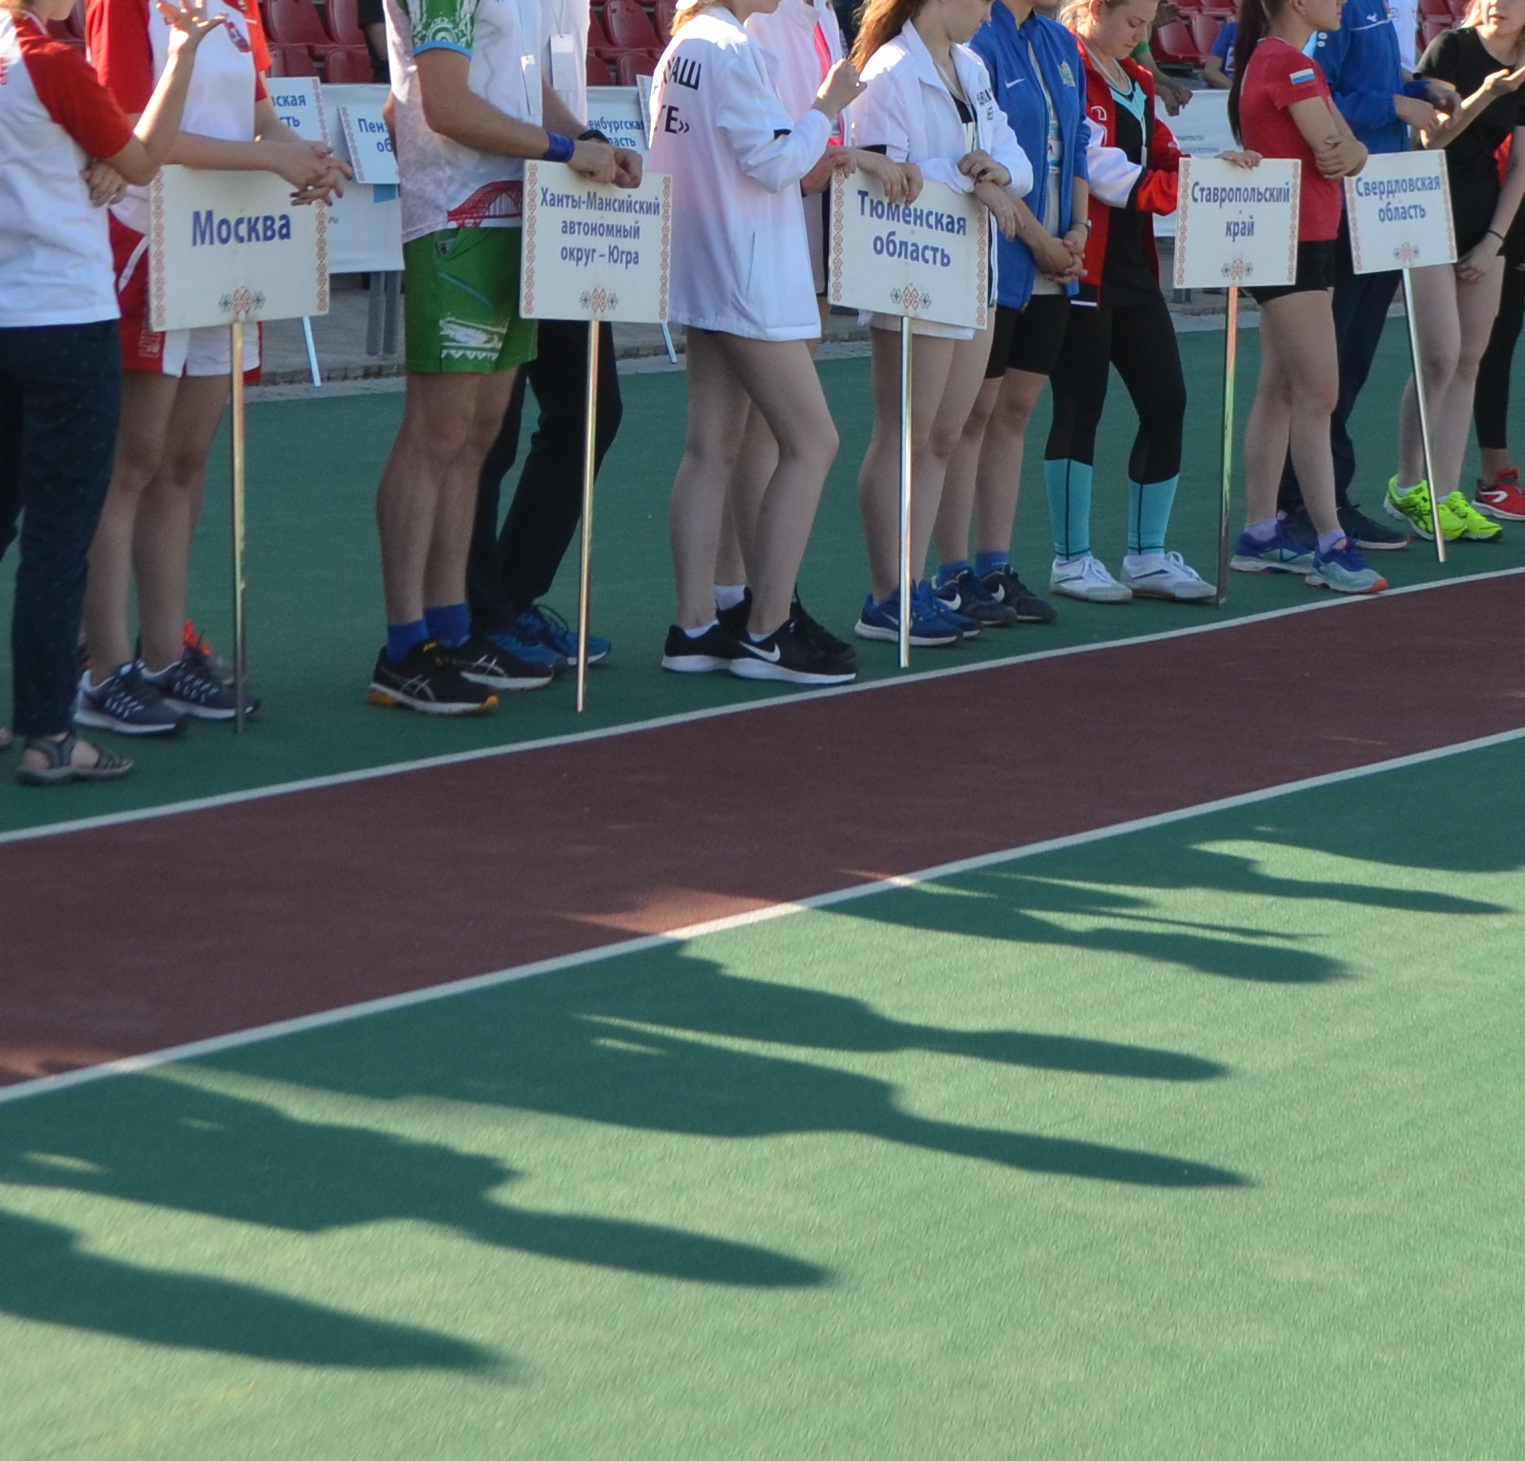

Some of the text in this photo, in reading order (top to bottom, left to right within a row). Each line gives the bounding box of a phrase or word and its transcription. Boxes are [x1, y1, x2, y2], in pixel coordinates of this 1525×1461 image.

[357, 117, 386, 133] Пен
[376, 137, 394, 153] об
[540, 186, 661, 217] Ханты-Мансийский
[1191, 181, 1290, 209] Ставропольский
[1355, 175, 1442, 201] Свердловская
[857, 189, 967, 236] Тюменская
[1377, 201, 1427, 223] область
[191, 209, 292, 247] Москва
[560, 218, 641, 241] автономный
[1225, 214, 1255, 243] край
[560, 244, 597, 267] округ
[607, 244, 640, 270] Югра
[872, 230, 951, 268] область
